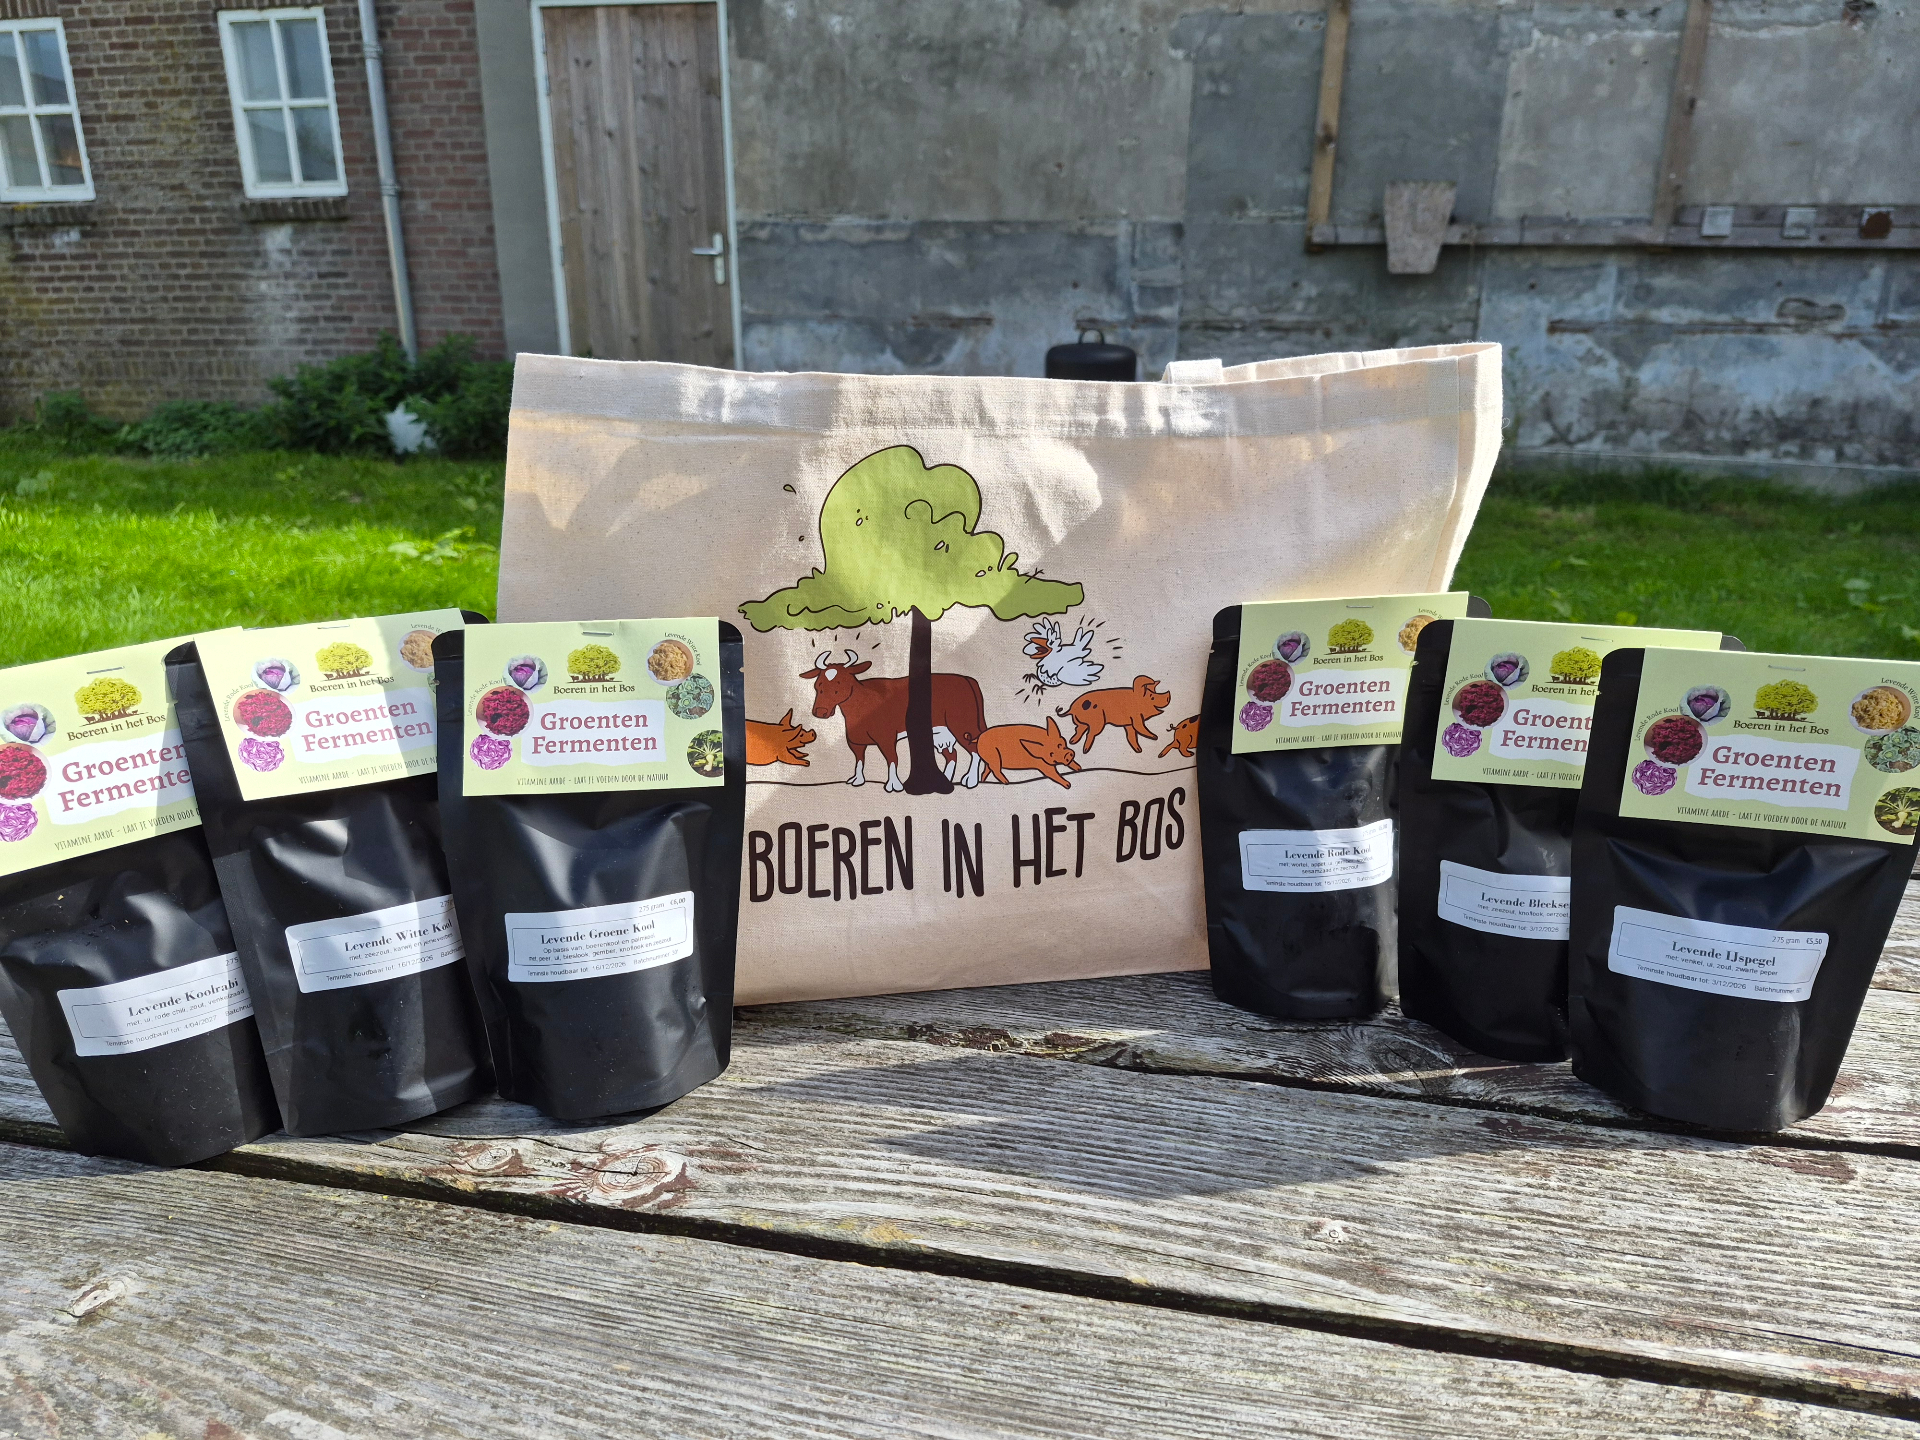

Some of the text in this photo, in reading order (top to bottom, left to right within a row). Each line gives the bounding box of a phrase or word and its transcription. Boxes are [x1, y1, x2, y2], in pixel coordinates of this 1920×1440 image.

[1313, 657, 1342, 665] Boeren
[1354, 655, 1368, 663] het
[1369, 654, 1384, 662] Bos
[309, 675, 395, 693] Boeren in het Bos
[553, 683, 636, 695] Boeren in het Bos
[1299, 680, 1391, 697] Groenten
[1531, 684, 1596, 696] Boeren in het
[1881, 677, 1909, 690] Levende
[305, 701, 417, 728] Groenten
[1289, 699, 1396, 717] Fermenten
[66, 714, 166, 741] Boeren in het Bos
[540, 712, 649, 731] Groenten
[1512, 708, 1593, 730] Groent
[1733, 719, 1829, 735] Boeren in het Bos
[302, 720, 433, 752] Fermenten
[531, 735, 658, 755] Fermenten
[1500, 729, 1588, 753] Fermen
[62, 743, 187, 783] Groenten
[1712, 745, 1836, 773] Groenten
[299, 772, 330, 784] VITAMINE
[332, 770, 350, 780] AARDE
[371, 766, 378, 775] JE
[380, 762, 403, 773] VOEDEN
[405, 759, 420, 768] DOOR
[421, 758, 429, 766] DE
[517, 777, 547, 786] VITAMINE
[588, 775, 594, 785] JE
[596, 775, 619, 784] VOEDEN
[621, 774, 636, 783] DOOR
[637, 774, 645, 782] DE
[646, 773, 669, 782] NATUUR
[1482, 767, 1581, 781] VITAMINE AARDE LAAT JE VOEDEN
[57, 769, 191, 812] Fermente
[1697, 768, 1842, 798] Fermenten
[1677, 806, 1847, 829] VITAMINE AARDE LAAT JE VOEDEN DOOR DE NATUUR
[54, 810, 195, 851] VITAMINE AARDE LAAT JE VOEDEN DOOR
[748, 786, 1186, 902] BOEREN IN HET BOS
[1285, 843, 1371, 859] Levende Rode Kool
[639, 904, 650, 913] 275
[1481, 892, 1569, 909] Levende Bleekse
[345, 918, 453, 952] Levende Witte Kool
[541, 919, 655, 945] Levende Groene Kool
[585, 940, 620, 949] boerenkool
[225, 956, 239, 967] 275
[1672, 941, 1776, 968] Levende IJspegel
[551, 968, 579, 976] houdbaar
[1666, 970, 1698, 982] houdbaar
[1712, 980, 1747, 990] 3/12/2026
[1735, 966, 1758, 974] zwarte
[1759, 969, 1778, 977] peper
[128, 977, 239, 1017] Levende Koolrabi
[154, 1012, 170, 1020] rode
